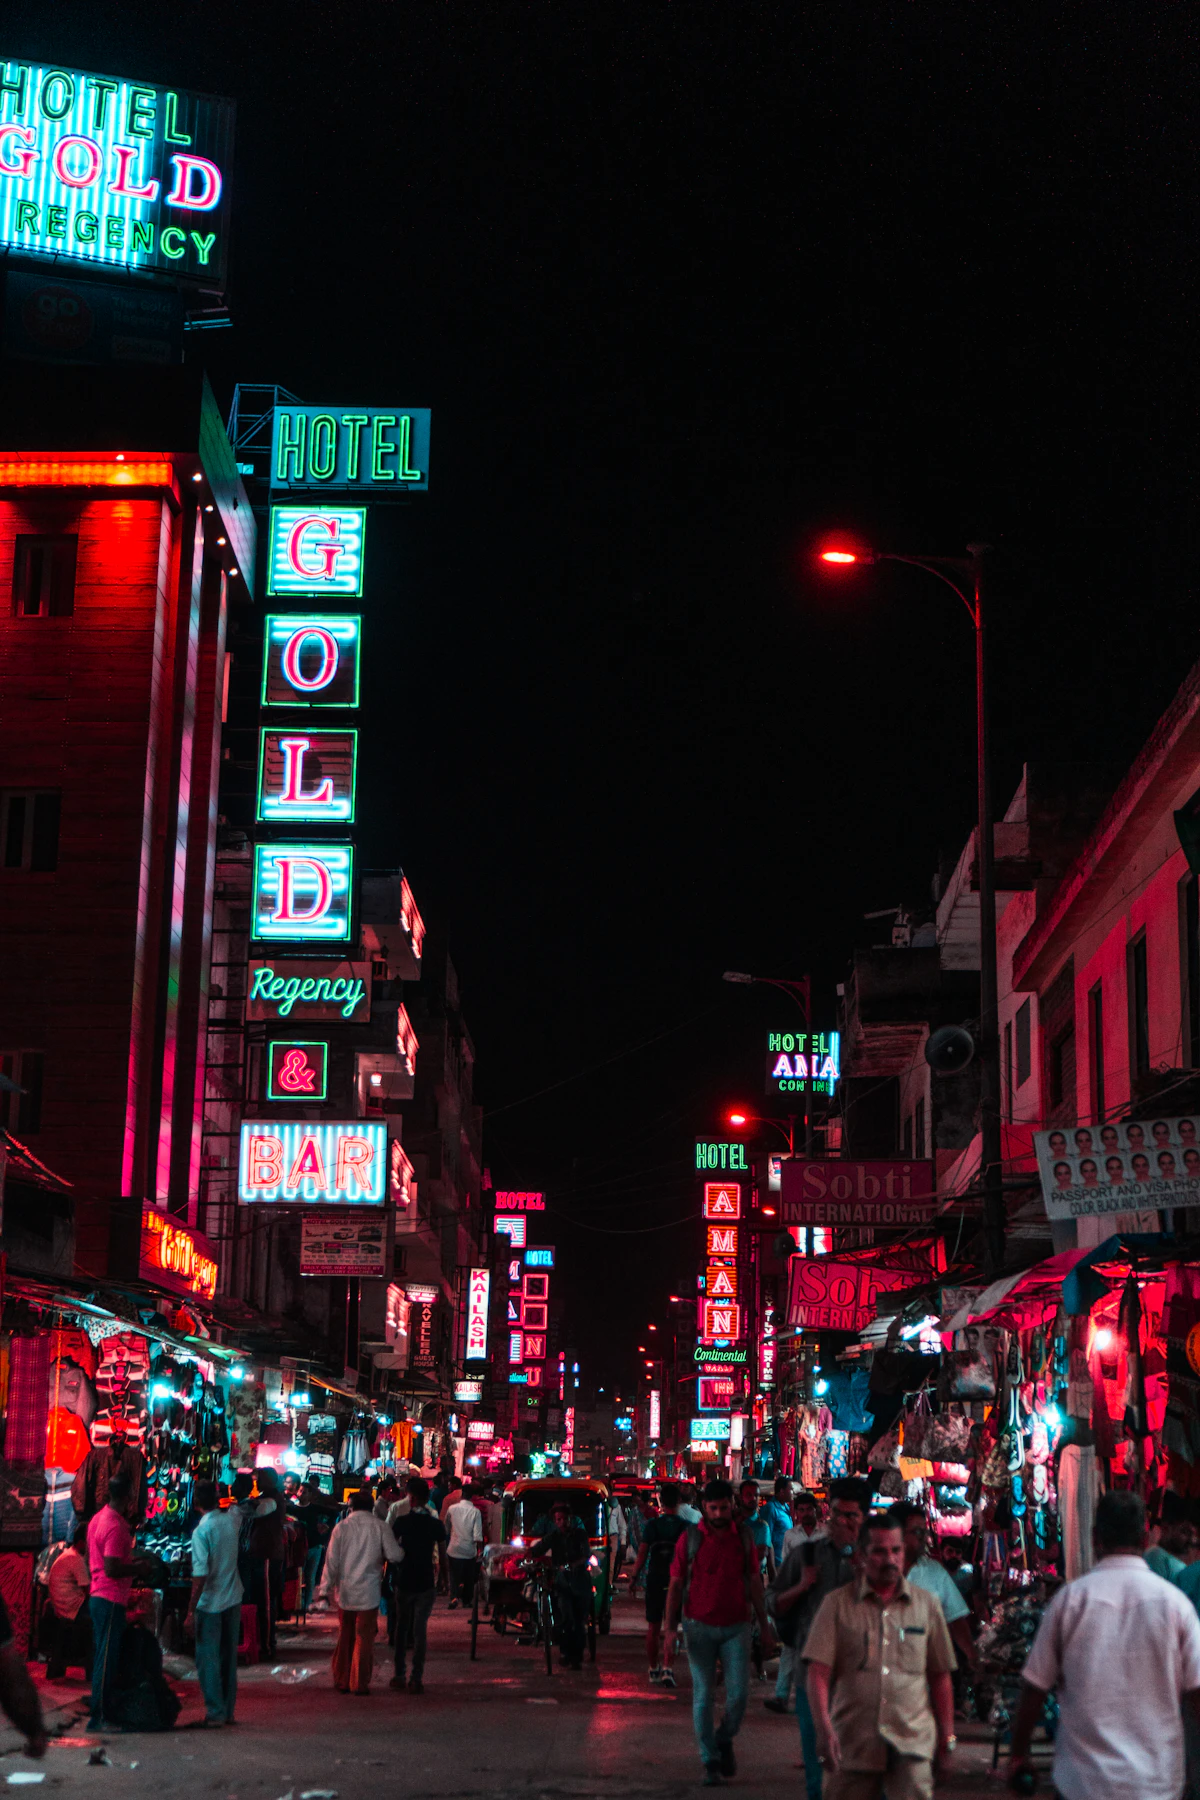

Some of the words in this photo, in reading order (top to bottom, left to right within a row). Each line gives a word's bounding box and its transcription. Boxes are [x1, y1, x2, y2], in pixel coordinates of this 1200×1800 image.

[0, 62, 191, 146] HOTEL
[0, 123, 223, 211] GOLD
[16, 201, 217, 265] REGENCY
[277, 413, 421, 480] HOTEL
[272, 515, 344, 923] GOLD
[250, 967, 365, 1018] Regency
[768, 1033, 829, 1053] HOTEL
[278, 1049, 316, 1092] &
[249, 1135, 374, 1190] BAR
[696, 1143, 748, 1170] HOTEL
[803, 1165, 912, 1201] Sobti
[1051, 1188, 1113, 1203] PASSPORT
[1117, 1183, 1142, 1197] AND
[1144, 1181, 1172, 1193] VISA
[495, 1191, 545, 1211] HOTEL
[783, 1203, 931, 1223] INTERNATIONAL
[526, 1250, 554, 1266] HOTEL
[711, 1190, 735, 1334] AMAN
[469, 1270, 488, 1348] KAILASH
[694, 1347, 747, 1364] Continental
[762, 1349, 774, 1381] EXIMS
[454, 1384, 482, 1393] KAILASH
[714, 1382, 734, 1394] INN
[468, 1422, 494, 1433] KIRAN
[693, 1422, 729, 1435] BAR
[692, 1441, 717, 1452] BAR
